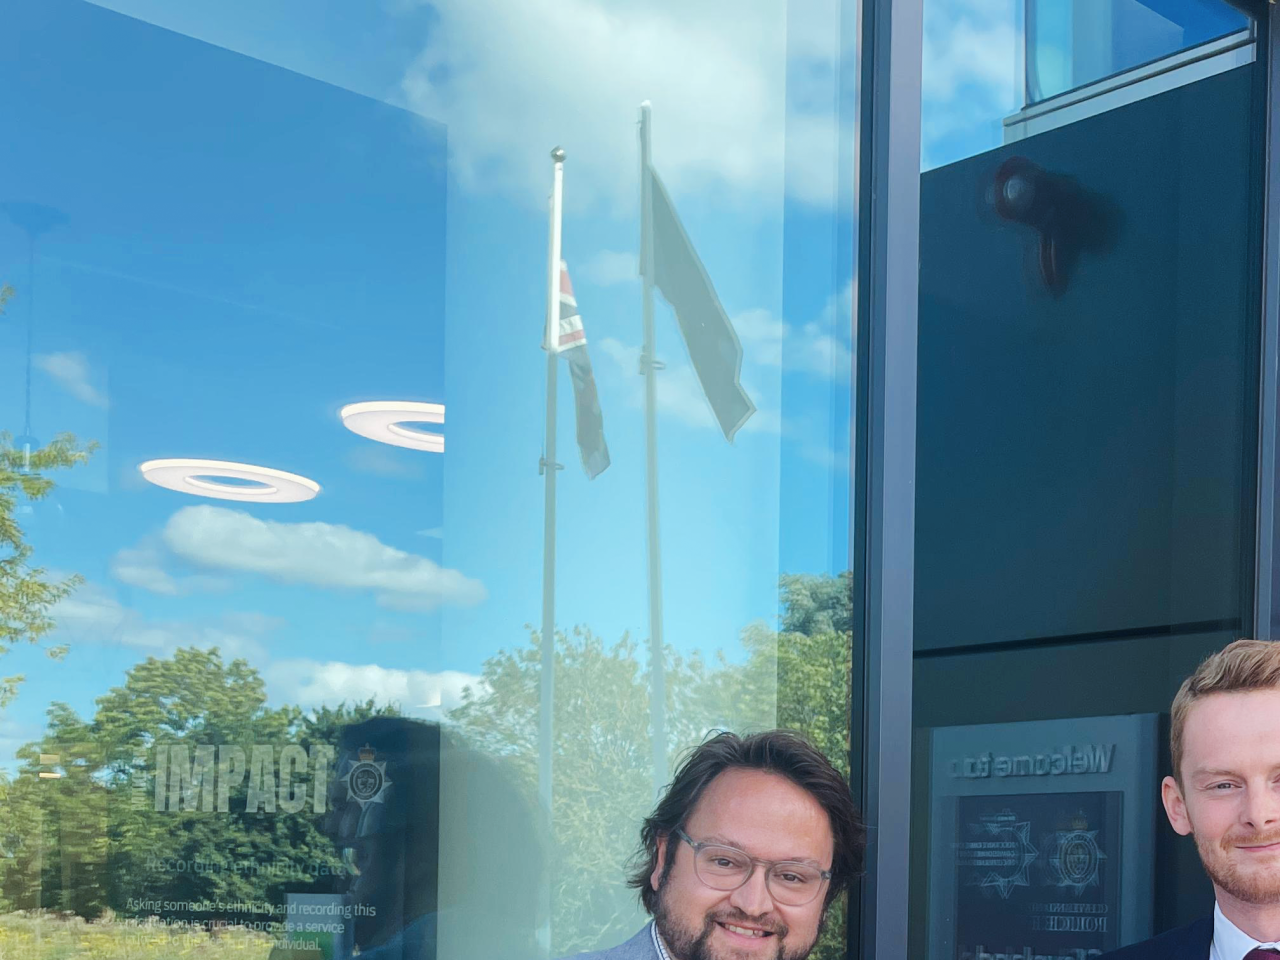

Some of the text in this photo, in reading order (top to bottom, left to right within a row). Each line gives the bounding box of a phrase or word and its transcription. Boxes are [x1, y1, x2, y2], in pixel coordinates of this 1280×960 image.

[155, 745, 334, 814] IMPACT
[126, 898, 162, 913] Asking
[226, 900, 274, 917] ethnicity
[277, 903, 296, 914] and
[299, 903, 351, 919] recording
[354, 903, 376, 917] this
[305, 921, 344, 933] service
